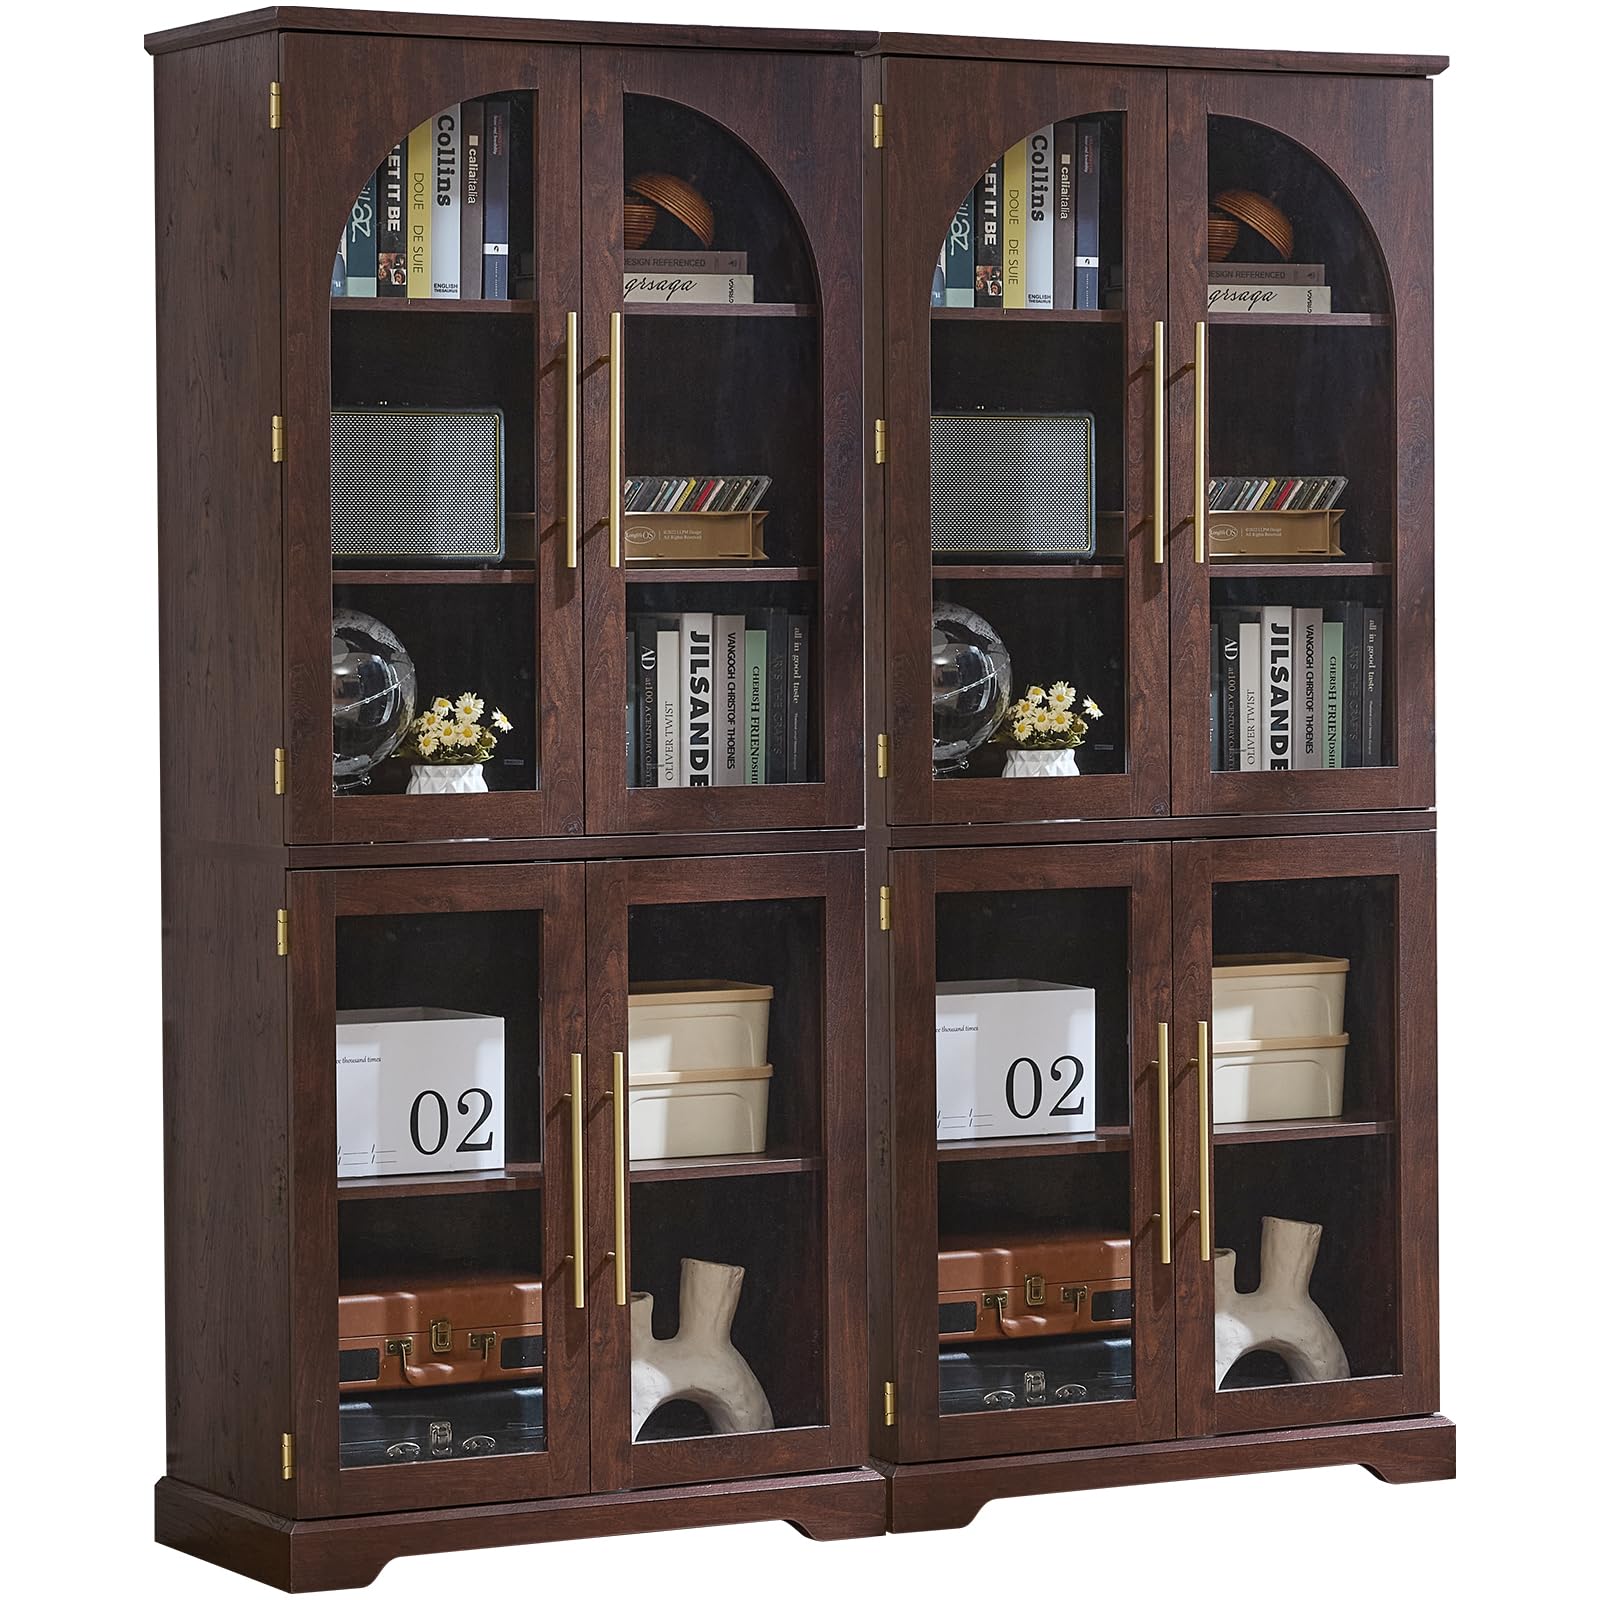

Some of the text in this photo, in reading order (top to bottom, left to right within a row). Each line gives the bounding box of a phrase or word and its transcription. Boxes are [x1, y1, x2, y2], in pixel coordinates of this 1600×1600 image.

[437, 115, 455, 207] Collins
[387, 183, 401, 201] IT
[1031, 135, 1048, 222] Collins
[387, 207, 401, 232] BE
[412, 172, 424, 273] DOUE DE SUIE
[984, 200, 997, 217] IT
[984, 222, 997, 246] BE
[1008, 189, 1019, 285] DOUE DE SUIE
[653, 258, 706, 267] REFERENCED
[1235, 271, 1286, 279] REFERENCED
[1369, 619, 1377, 630] all
[1369, 633, 1377, 643] in
[641, 646, 656, 670] AD
[792, 627, 802, 703] all in good taste
[1224, 637, 1238, 660] AD
[1367, 646, 1376, 669] good
[751, 666, 760, 712] CHERISH
[1305, 624, 1314, 754] VANGOGH CHRISTOF THOENES
[1328, 656, 1337, 700] CHERISH
[1368, 671, 1376, 692] taste
[727, 632, 736, 769] VANGOGH CHRISTOF THOENES
[665, 701, 674, 781] OLIVER TWIST
[1247, 689, 1255, 765] OLIVER TWIST
[342, 1056, 366, 1064] thousand
[1005, 1055, 1085, 1119] 02
[409, 1088, 493, 1156] 02
